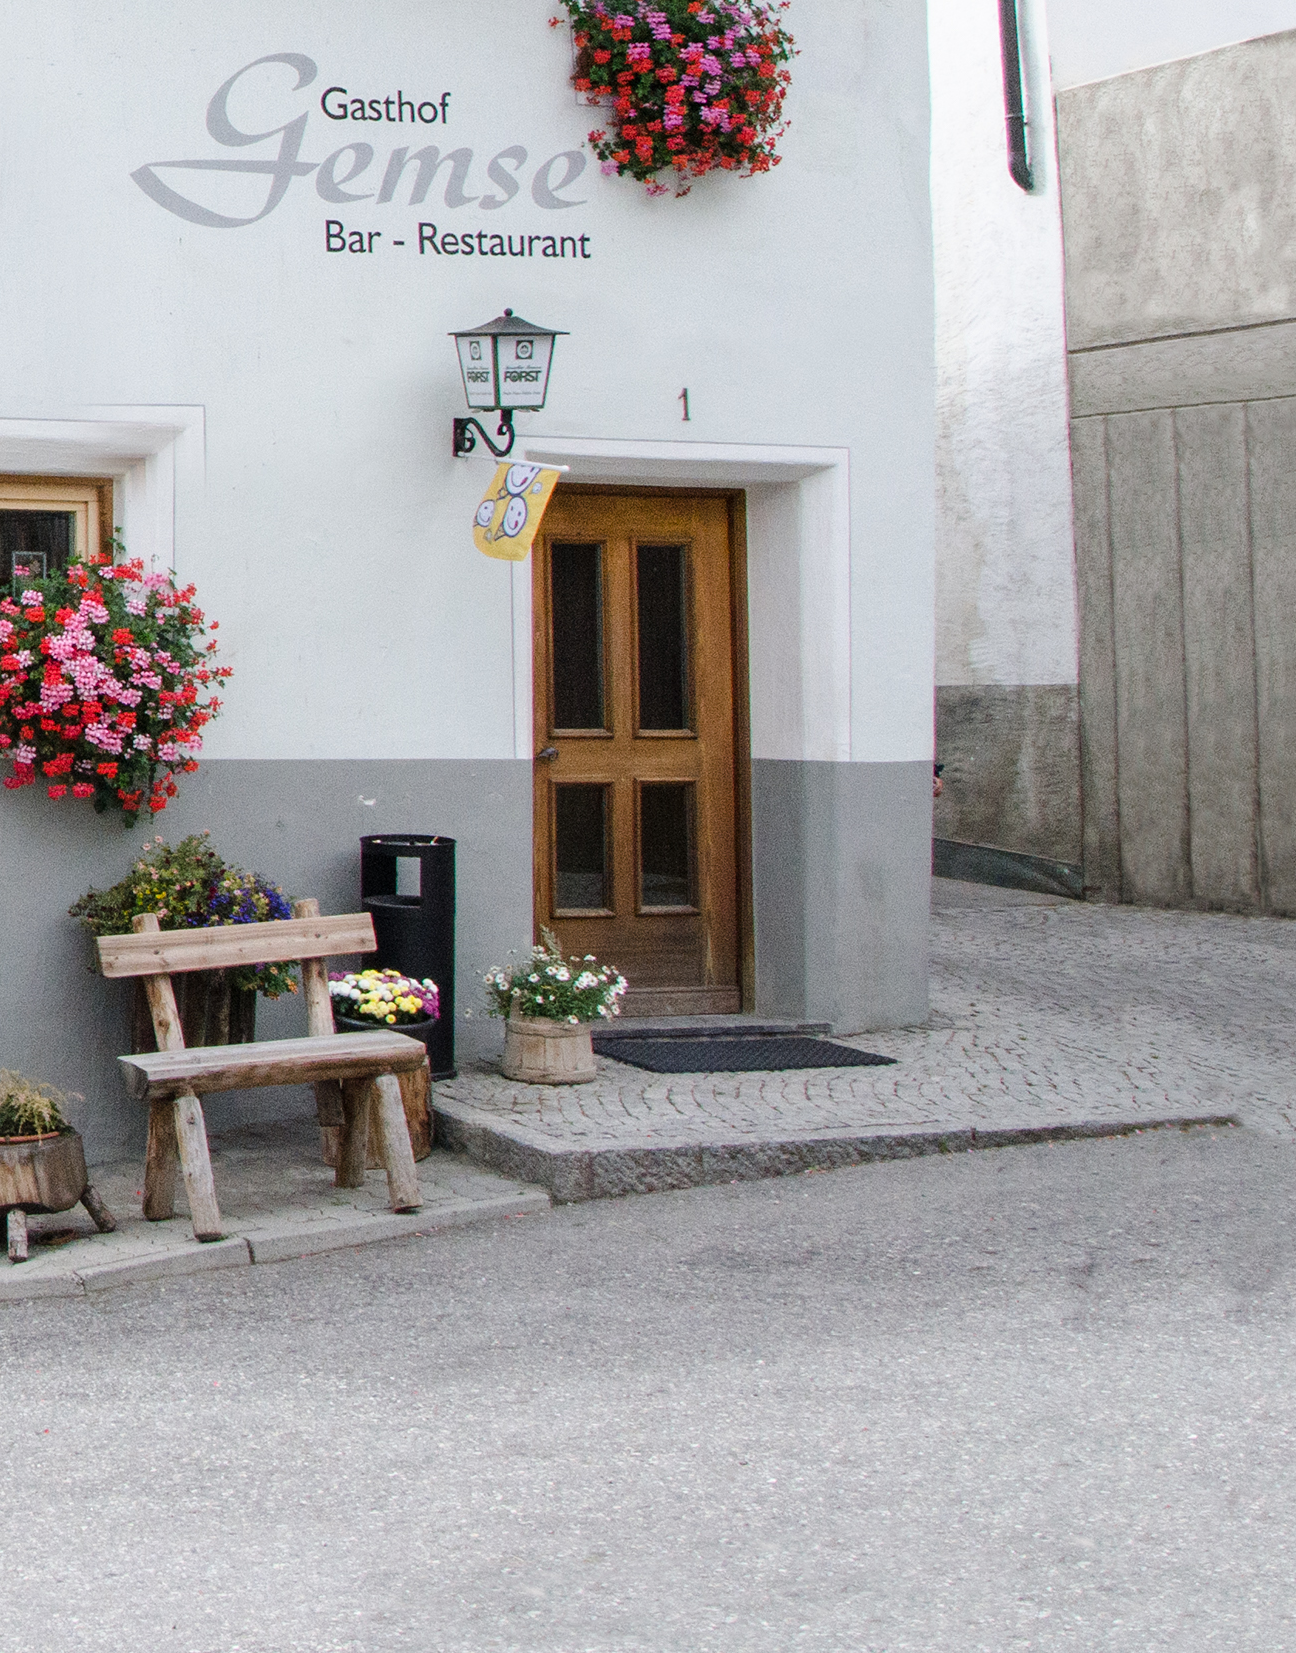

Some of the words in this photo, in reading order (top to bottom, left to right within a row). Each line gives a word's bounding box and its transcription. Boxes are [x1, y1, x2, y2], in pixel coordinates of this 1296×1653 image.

[320, 86, 452, 124] Gasthof
[130, 52, 589, 228] Gemse
[324, 219, 383, 254] Bar
[417, 222, 592, 259] Restaurant
[467, 371, 490, 383] FORST
[503, 370, 542, 383] FORST
[677, 387, 692, 422] 1
